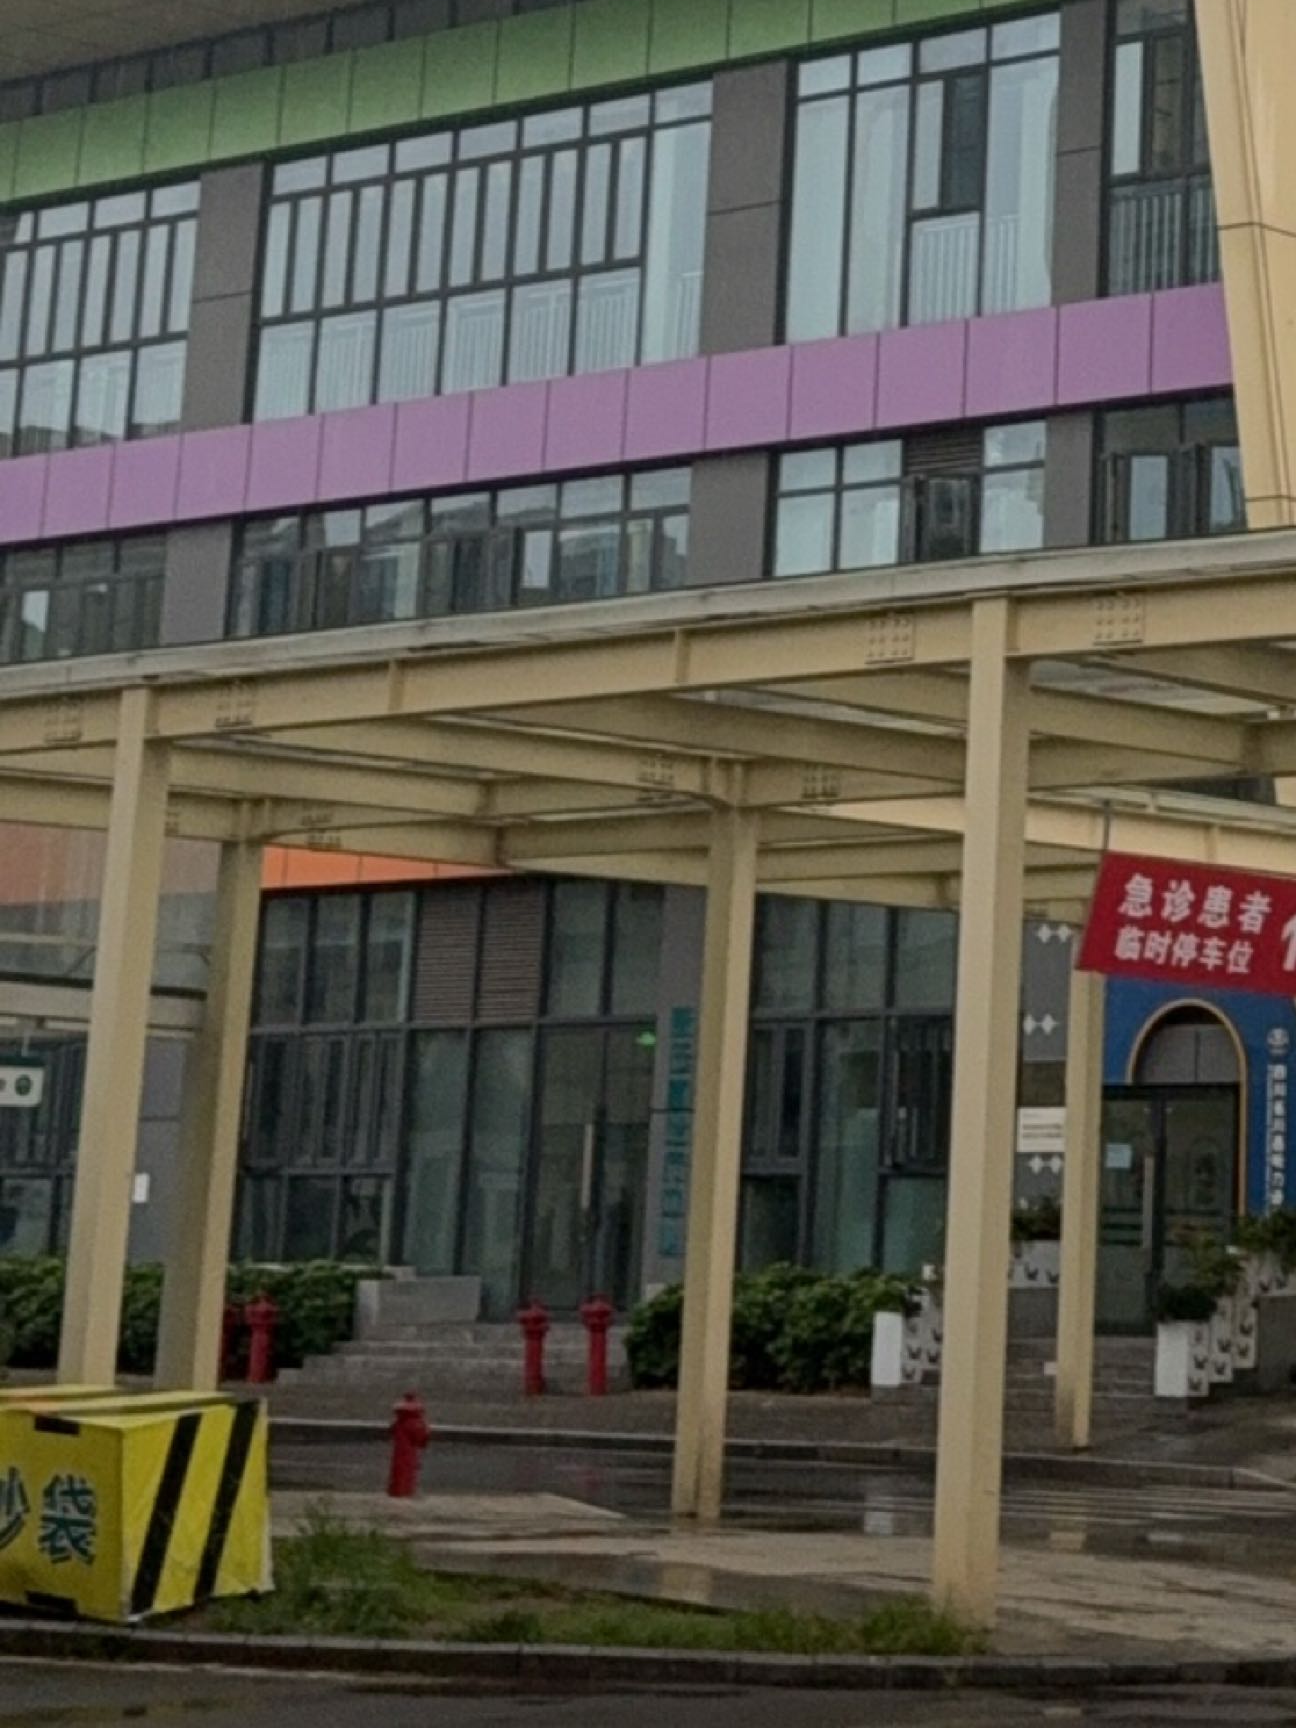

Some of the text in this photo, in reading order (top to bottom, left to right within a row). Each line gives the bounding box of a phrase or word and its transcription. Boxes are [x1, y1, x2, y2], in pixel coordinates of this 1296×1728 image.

[1117, 872, 1273, 935] 急诊患者
[1113, 924, 1254, 974] 临时停车位
